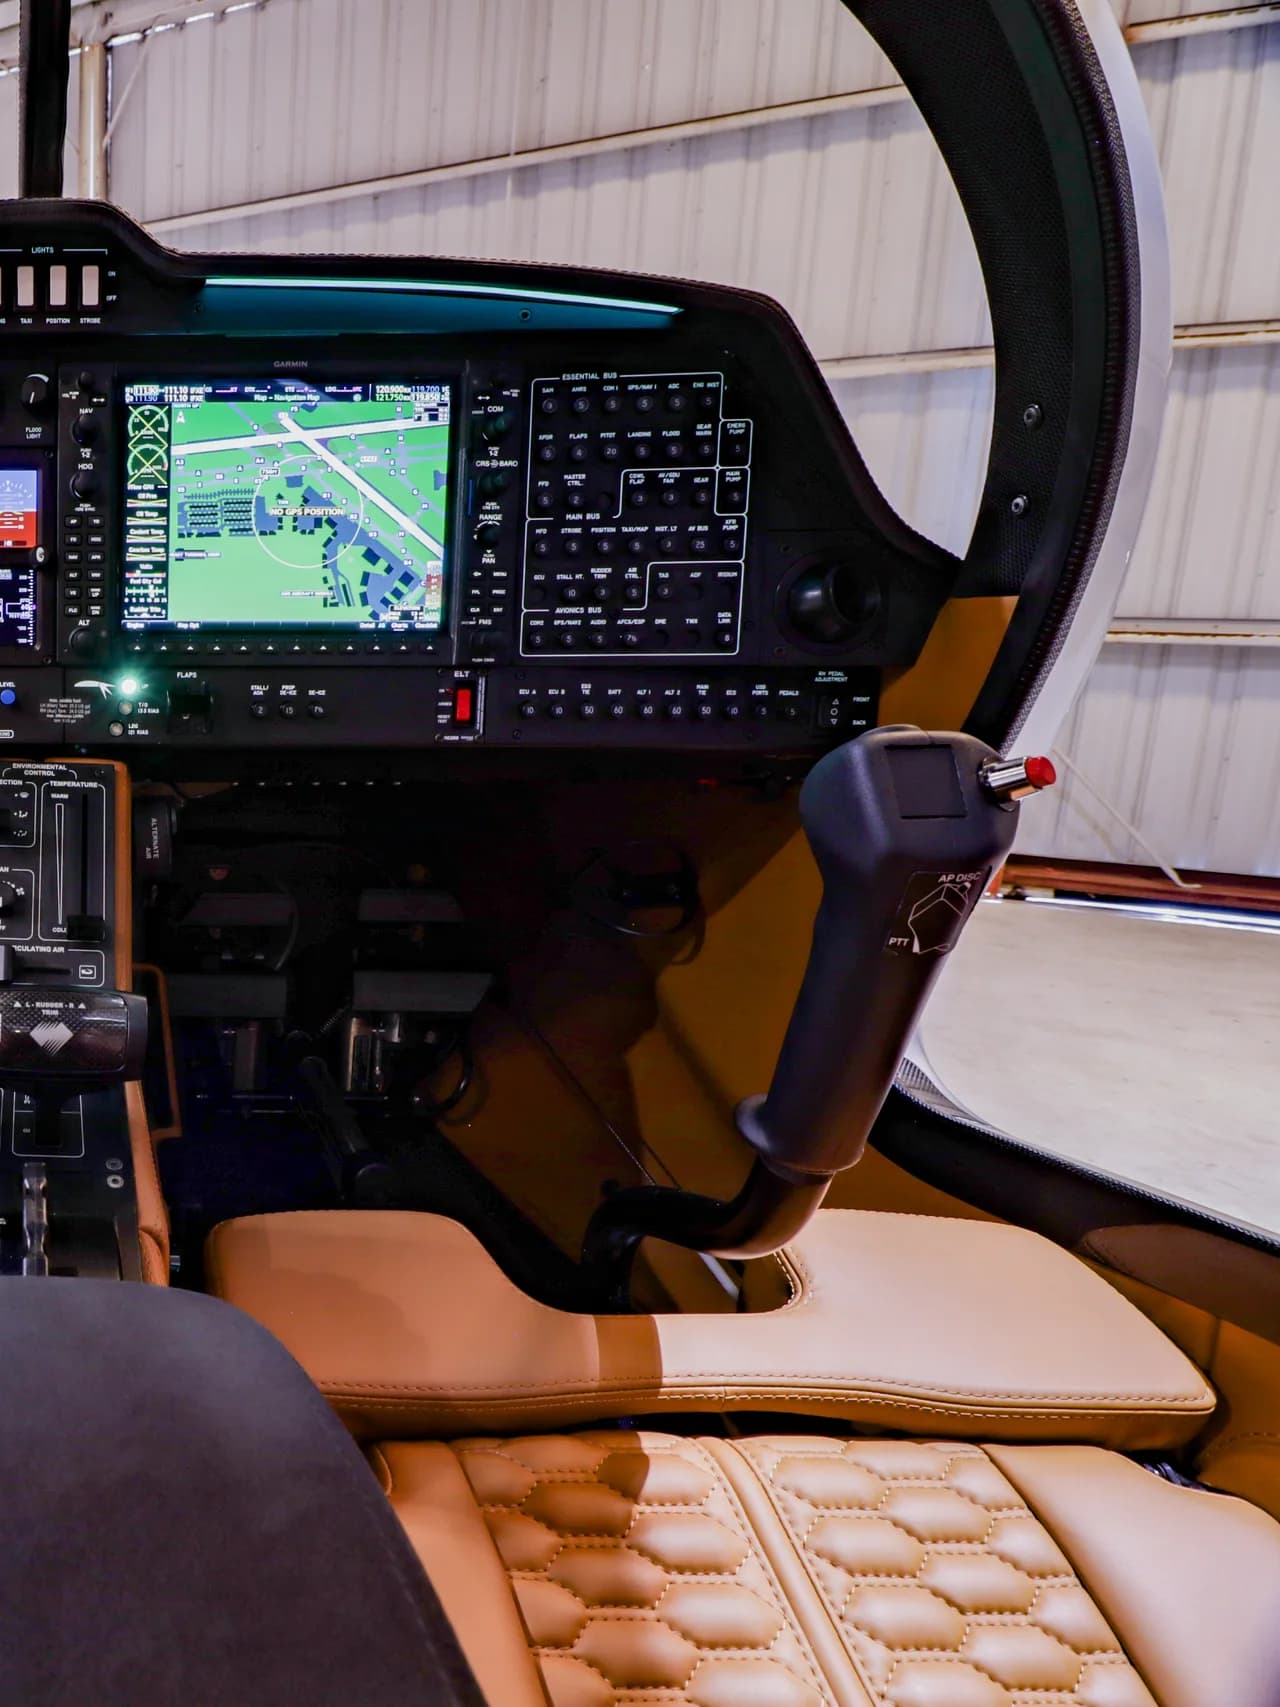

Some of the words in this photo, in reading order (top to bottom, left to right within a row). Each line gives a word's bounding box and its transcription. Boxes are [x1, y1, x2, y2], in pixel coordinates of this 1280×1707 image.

[270, 508, 283, 516] NO
[285, 508, 302, 516] GPS
[304, 508, 344, 516] POSITION
[938, 874, 955, 882] AP
[956, 872, 982, 882] DISC
[889, 938, 909, 947] PTT
